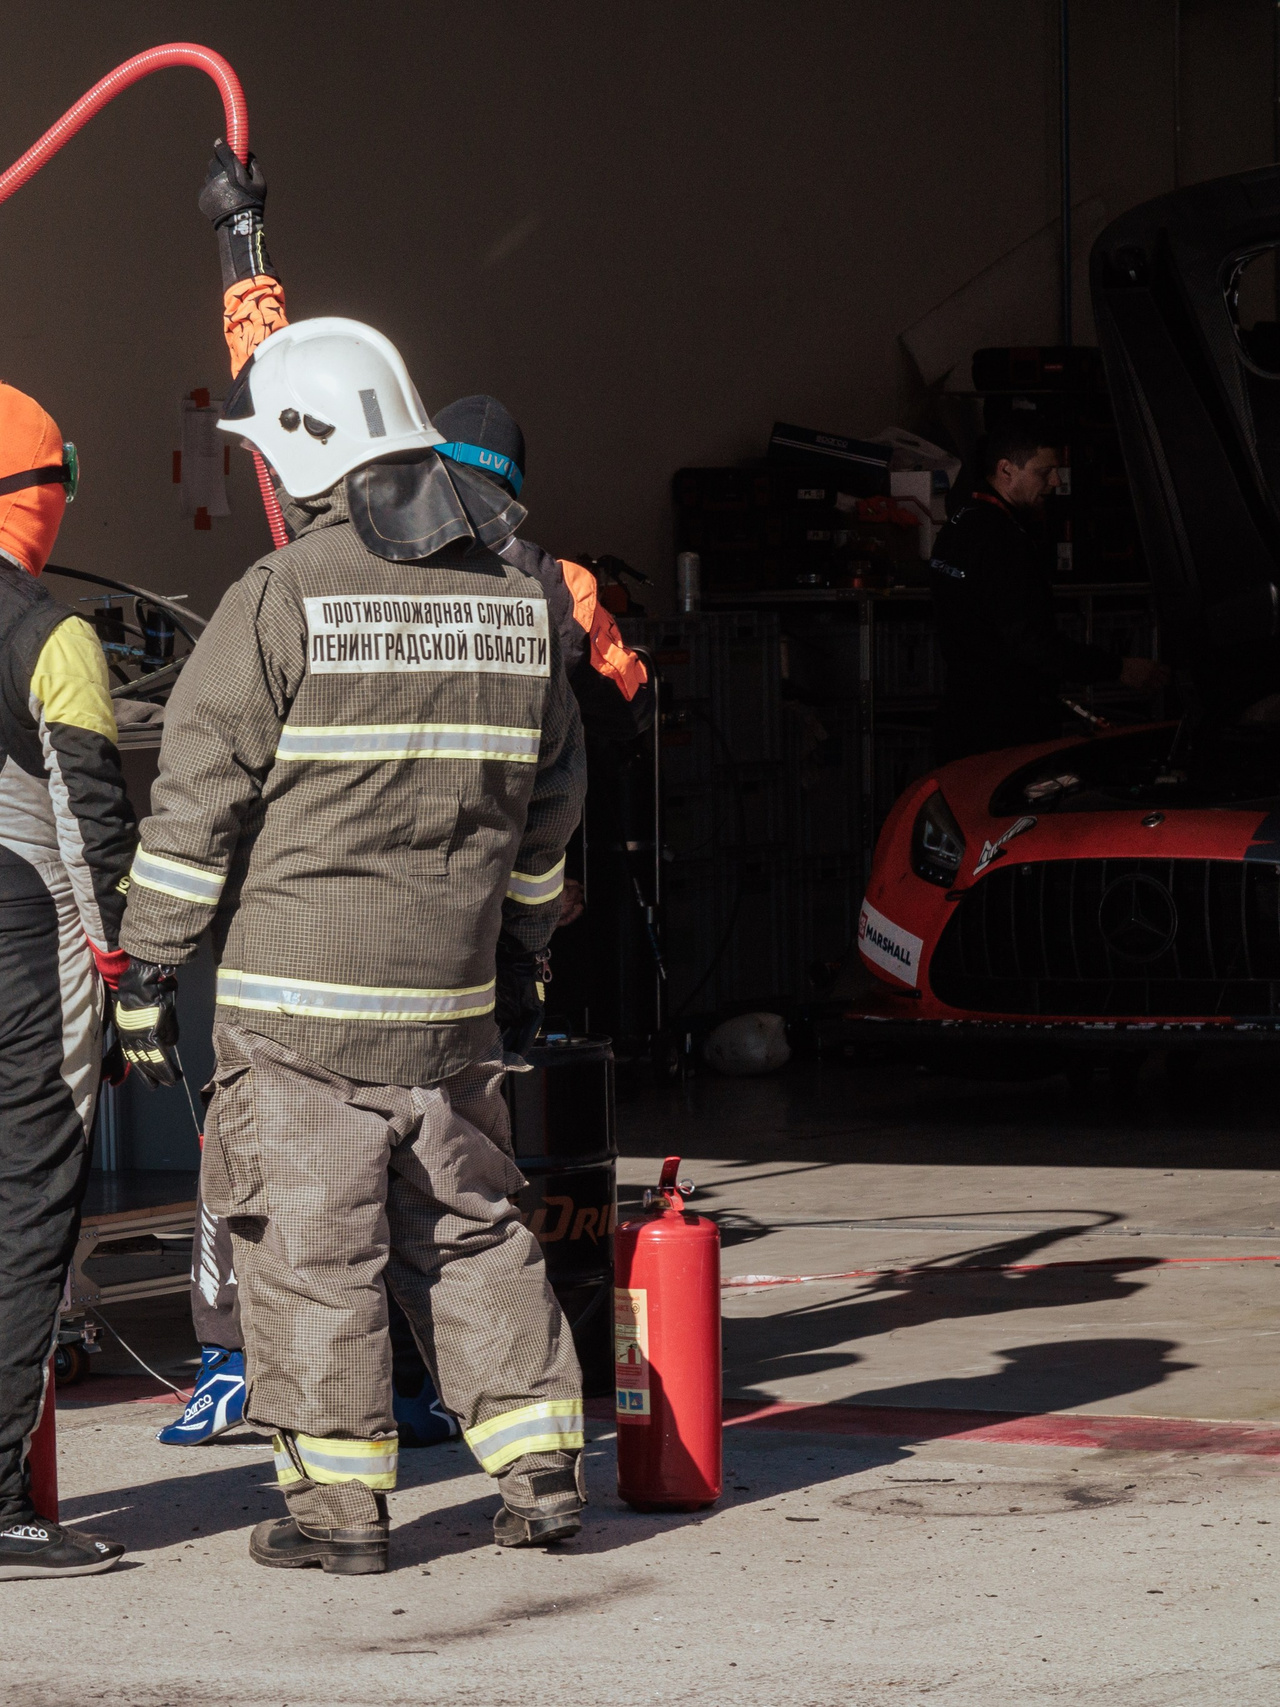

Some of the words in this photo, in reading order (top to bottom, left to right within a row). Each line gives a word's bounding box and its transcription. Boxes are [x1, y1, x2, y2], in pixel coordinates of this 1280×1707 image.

[322, 601, 473, 628] противопожарная
[477, 600, 535, 629] служба
[311, 628, 469, 665] ЛЕНИНГРАДСКОЙ
[474, 633, 547, 666] ОБЛАСТИ
[865, 924, 911, 967] MARSHALL
[183, 1394, 212, 1424] parco
